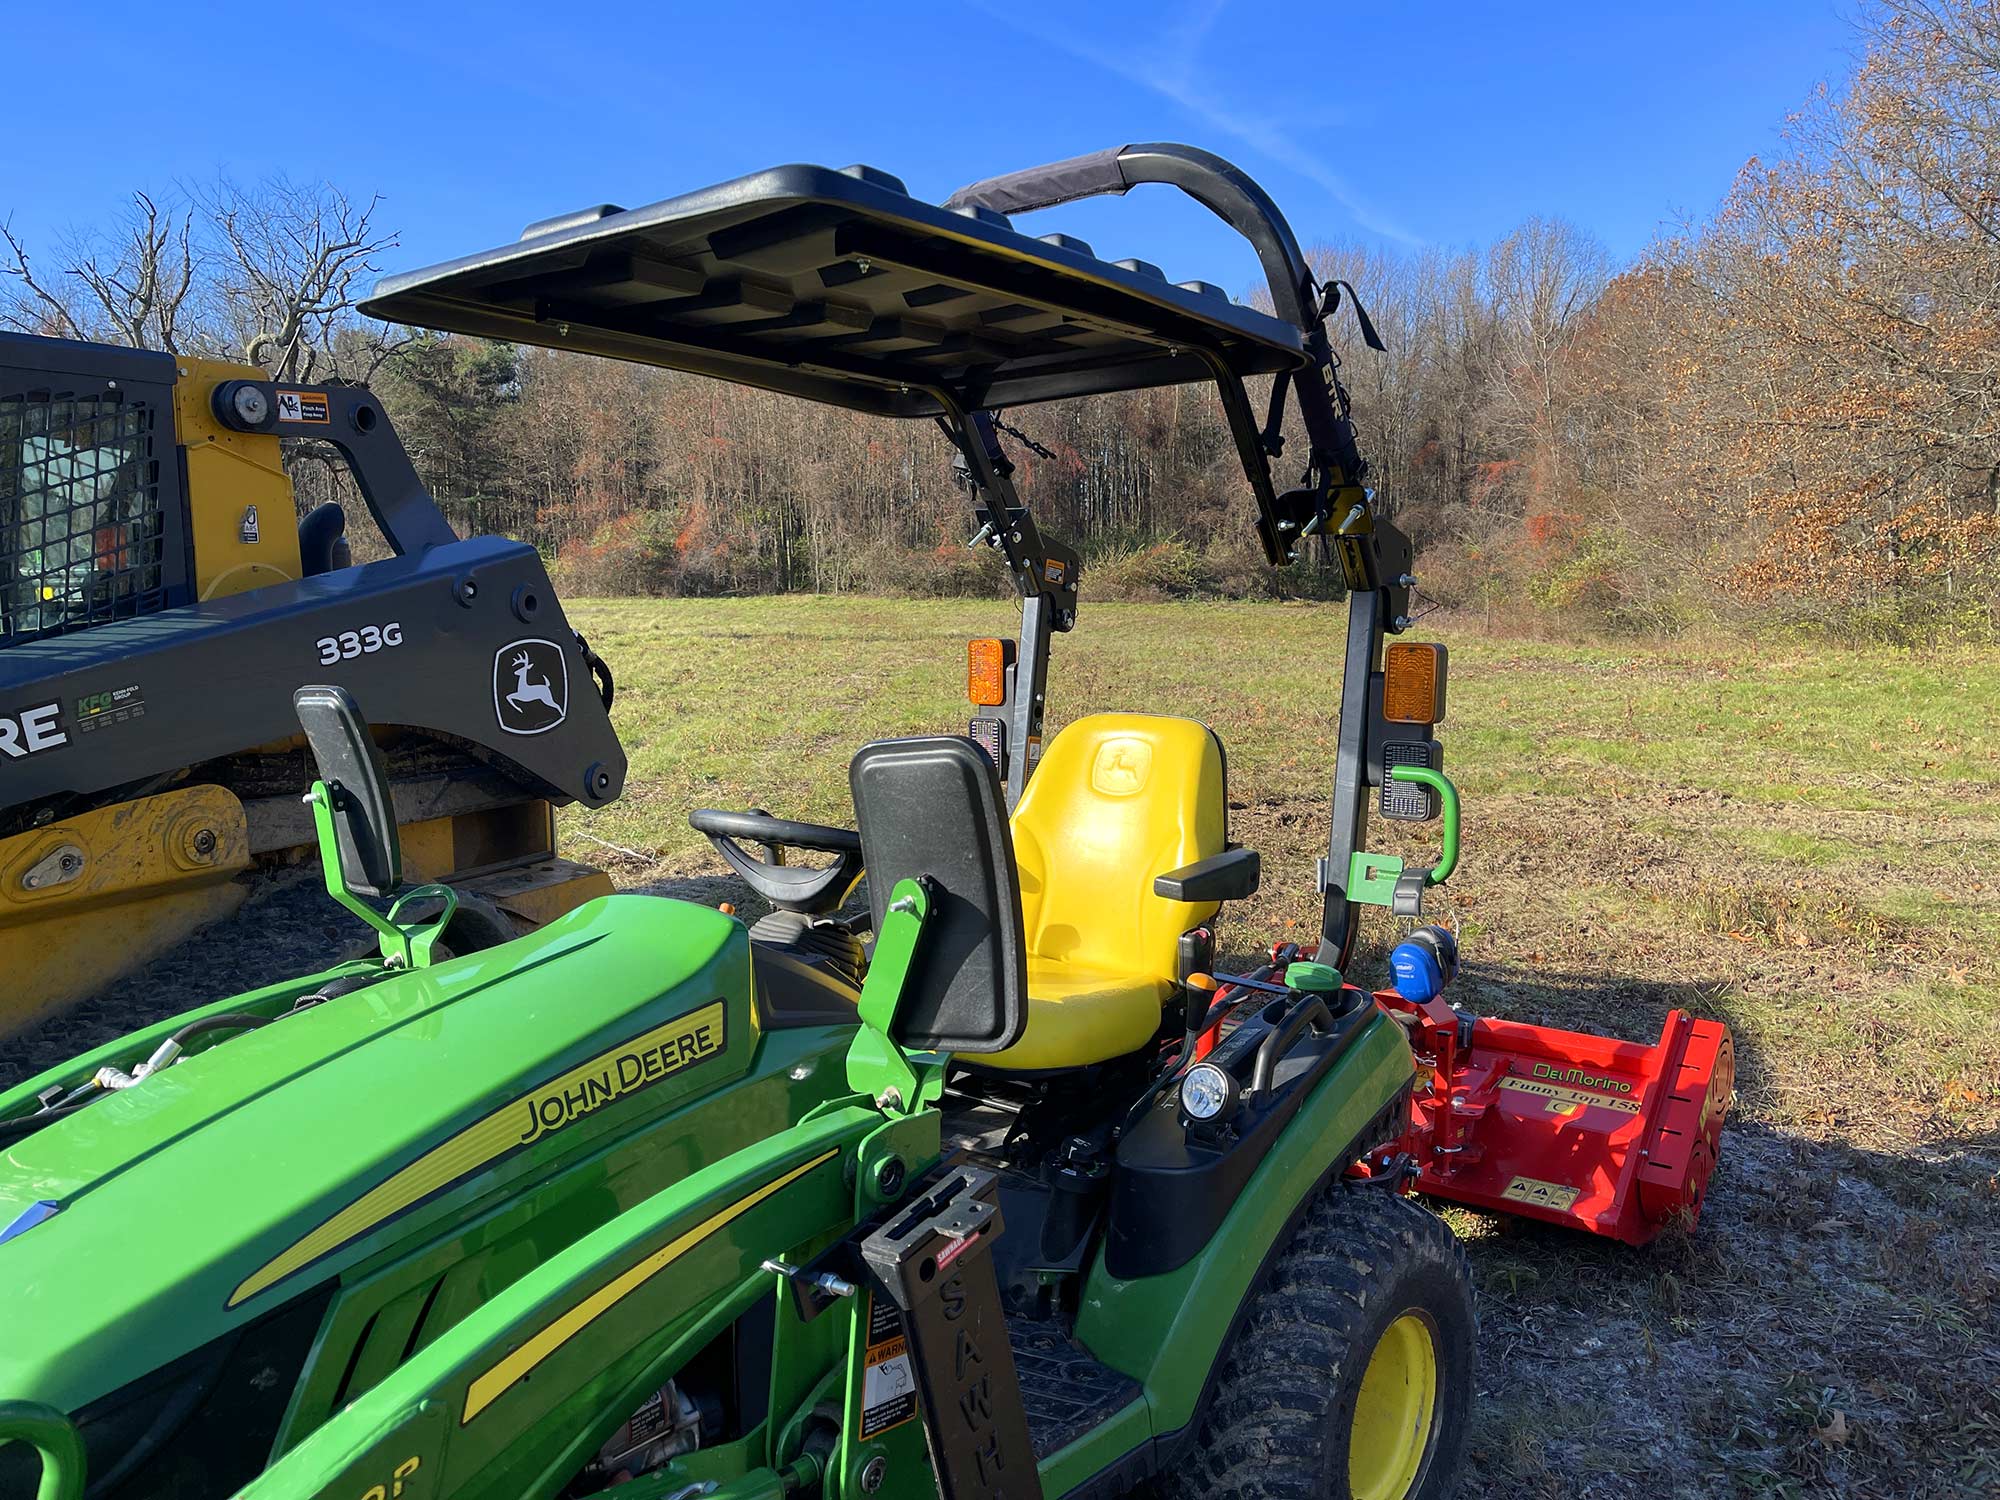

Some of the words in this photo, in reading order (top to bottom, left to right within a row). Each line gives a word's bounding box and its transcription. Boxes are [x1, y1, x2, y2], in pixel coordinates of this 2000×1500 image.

[1322, 363, 1343, 421] BTR
[316, 622, 403, 666] 333G
[78, 691, 112, 713] KFG
[520, 1071, 613, 1141] JOHN
[615, 1024, 715, 1090] DEERE
[1508, 1080, 1562, 1097] Funny
[1570, 1092, 1600, 1105] Top
[1608, 1098, 1641, 1113] 158
[878, 1343, 907, 1360] WARN
[940, 1274, 1005, 1500] SAWH
